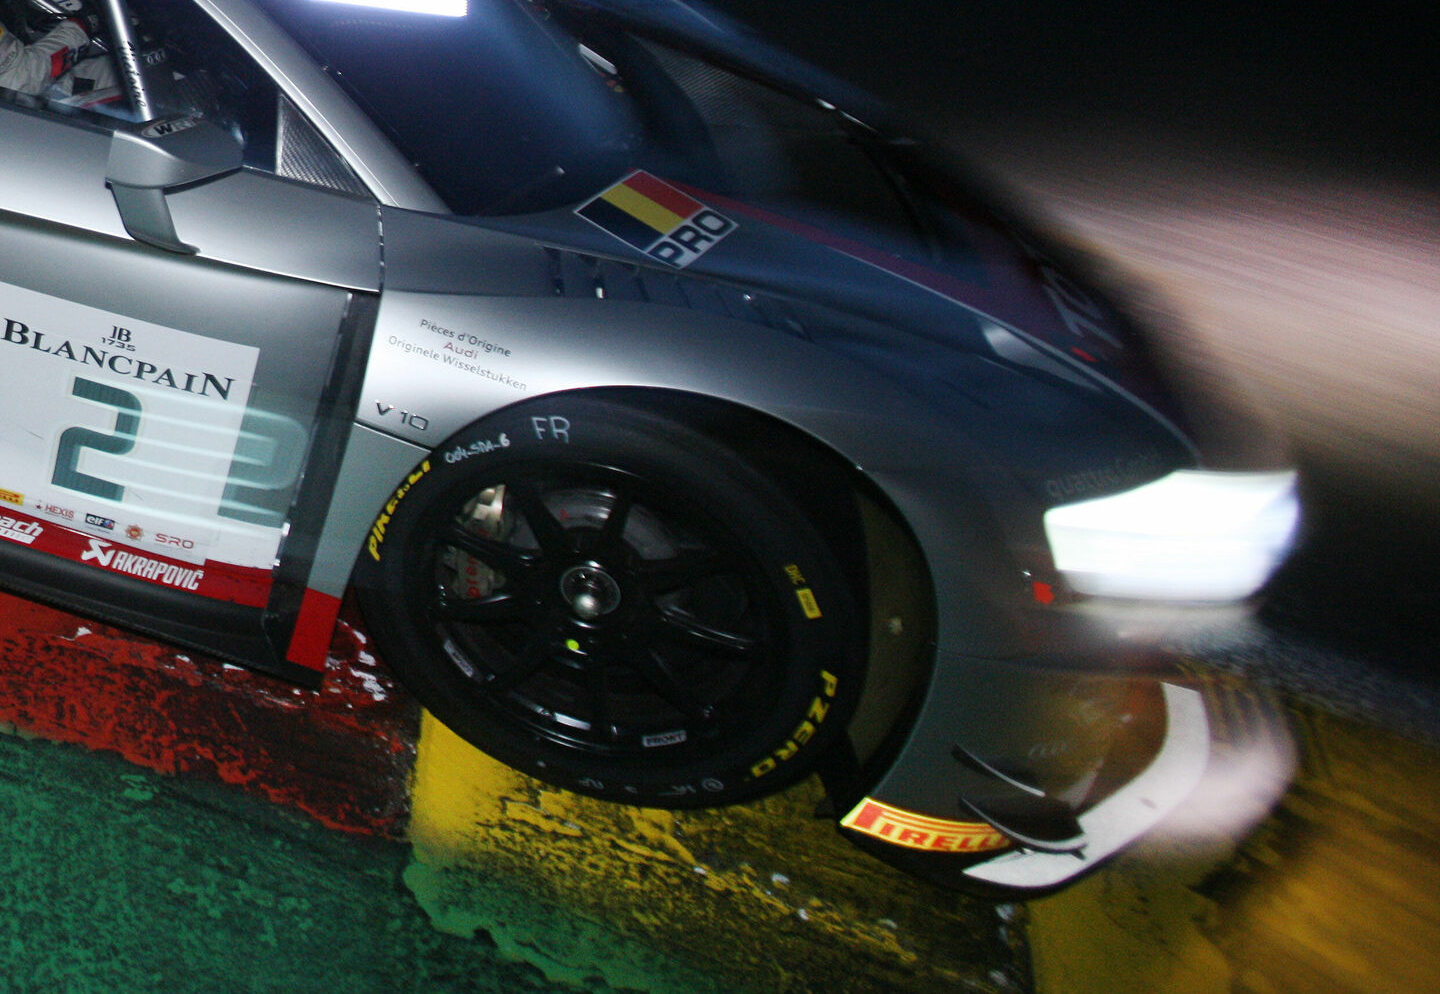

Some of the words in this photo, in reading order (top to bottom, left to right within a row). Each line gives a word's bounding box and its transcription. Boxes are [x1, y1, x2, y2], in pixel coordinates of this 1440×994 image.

[648, 209, 733, 268] PRO
[101, 336, 136, 352] 1735
[443, 341, 479, 361] Audi
[457, 332, 512, 357] d'Origine
[1, 317, 236, 401] BLANCPAIN
[388, 335, 441, 362] Originele
[443, 353, 527, 391] Wisselstukken
[531, 415, 570, 445] FR
[44, 503, 75, 519] HEXIS
[86, 514, 104, 527] elf
[154, 533, 195, 550] SRO
